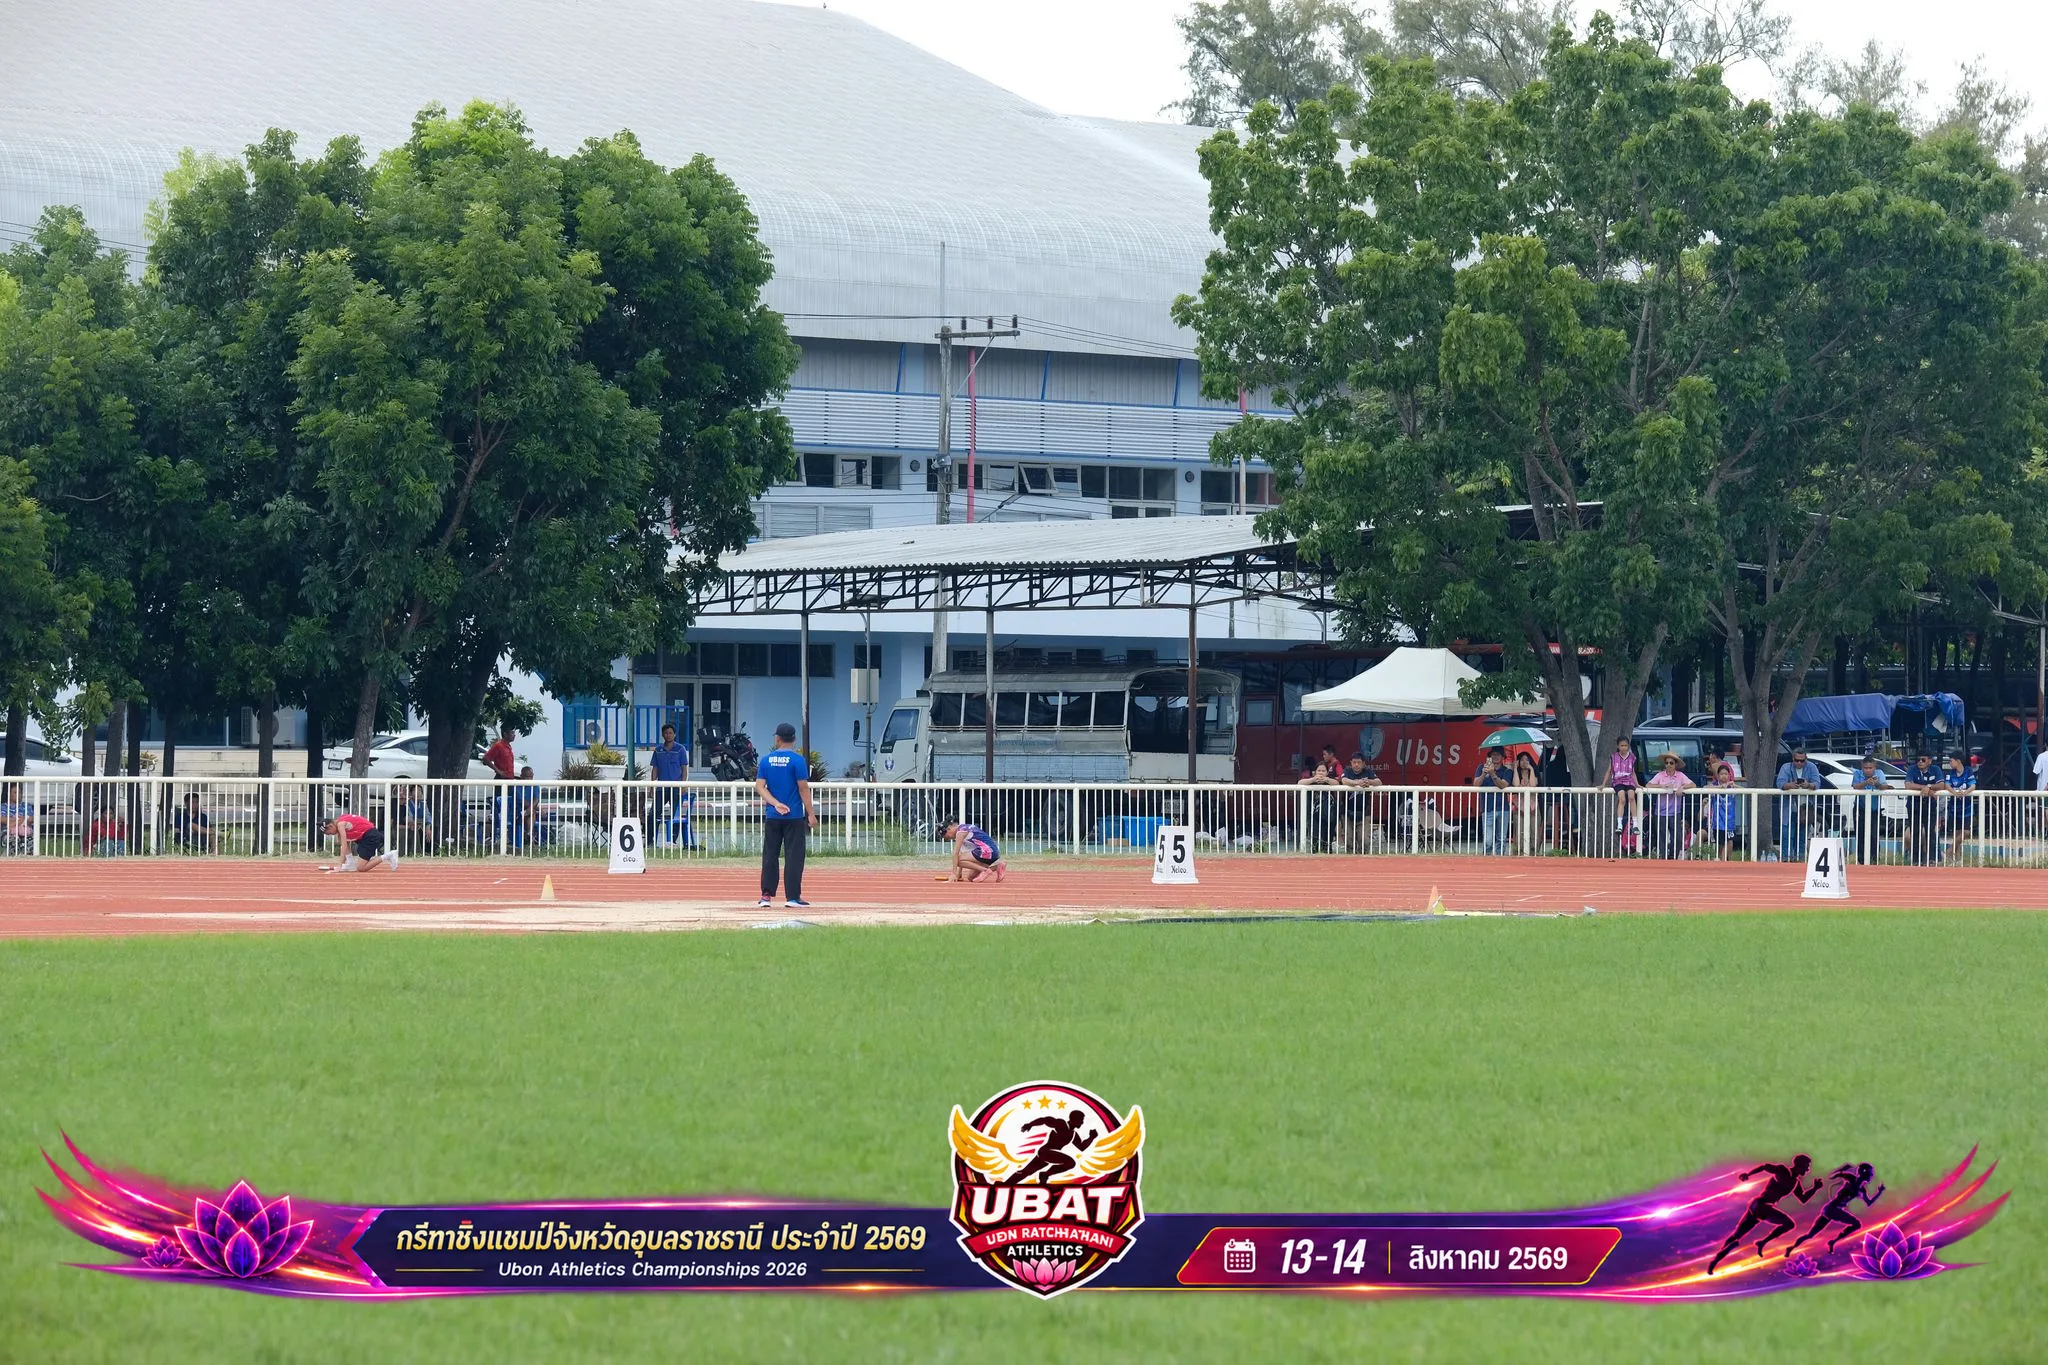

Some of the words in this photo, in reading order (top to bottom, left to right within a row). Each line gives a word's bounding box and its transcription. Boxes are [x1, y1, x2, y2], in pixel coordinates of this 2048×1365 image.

[1396, 738, 1461, 765] Ubss
[619, 824, 635, 853] 6
[1159, 835, 1165, 863] 5
[1173, 835, 1185, 863] 5
[1815, 847, 1830, 878] 4
